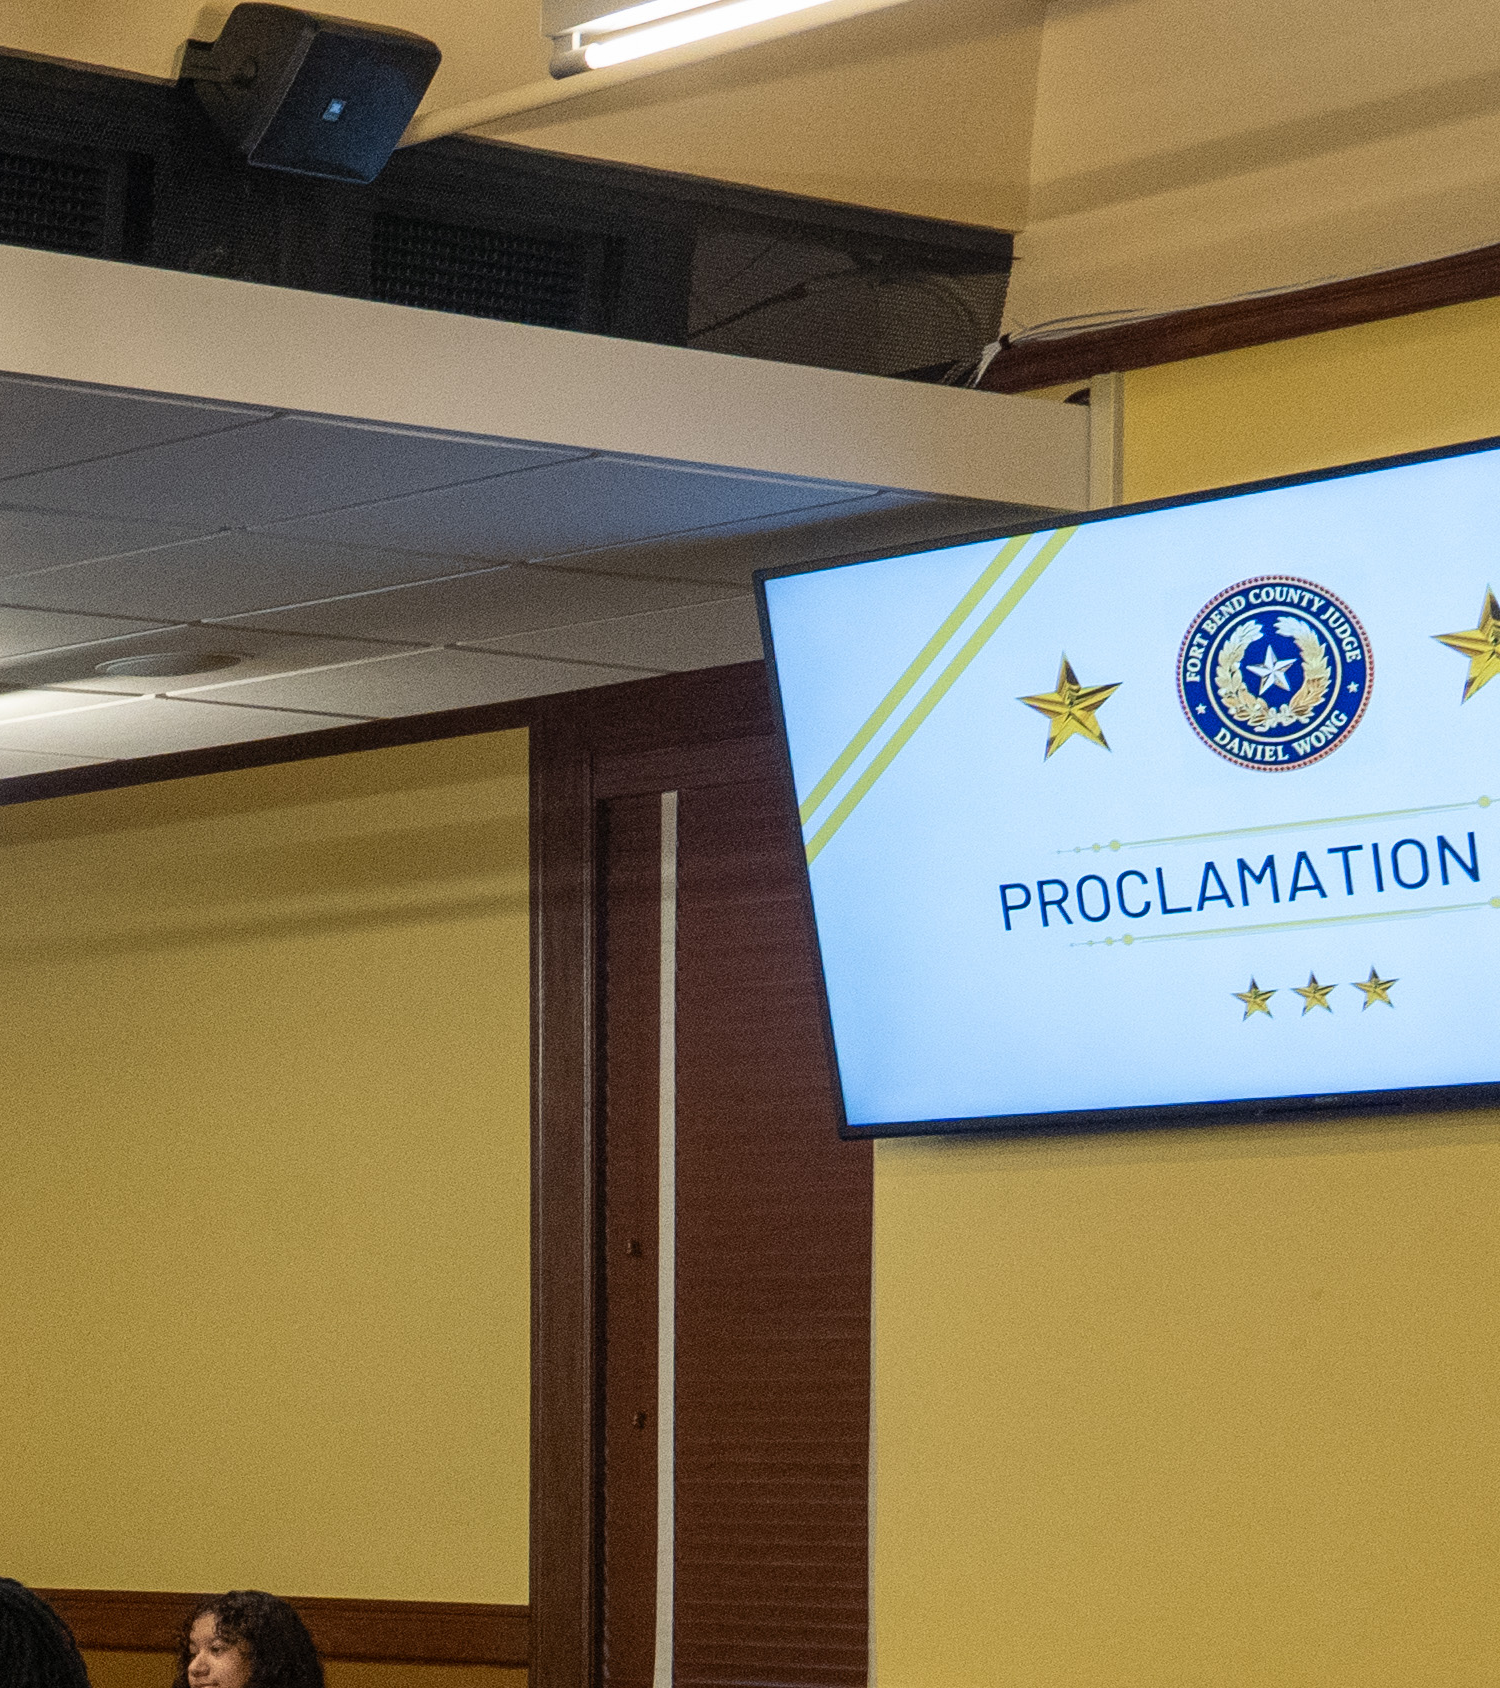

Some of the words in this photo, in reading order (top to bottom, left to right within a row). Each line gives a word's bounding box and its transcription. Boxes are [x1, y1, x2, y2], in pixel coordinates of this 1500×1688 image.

[1186, 632, 1208, 683] FORT
[1202, 596, 1246, 635] BEND
[1249, 587, 1326, 612] COUNTY
[1319, 606, 1362, 663] JUDGE
[1213, 727, 1289, 762] DANIEL
[1292, 710, 1349, 756] WONG
[999, 831, 1481, 931] PROCLAMATION
